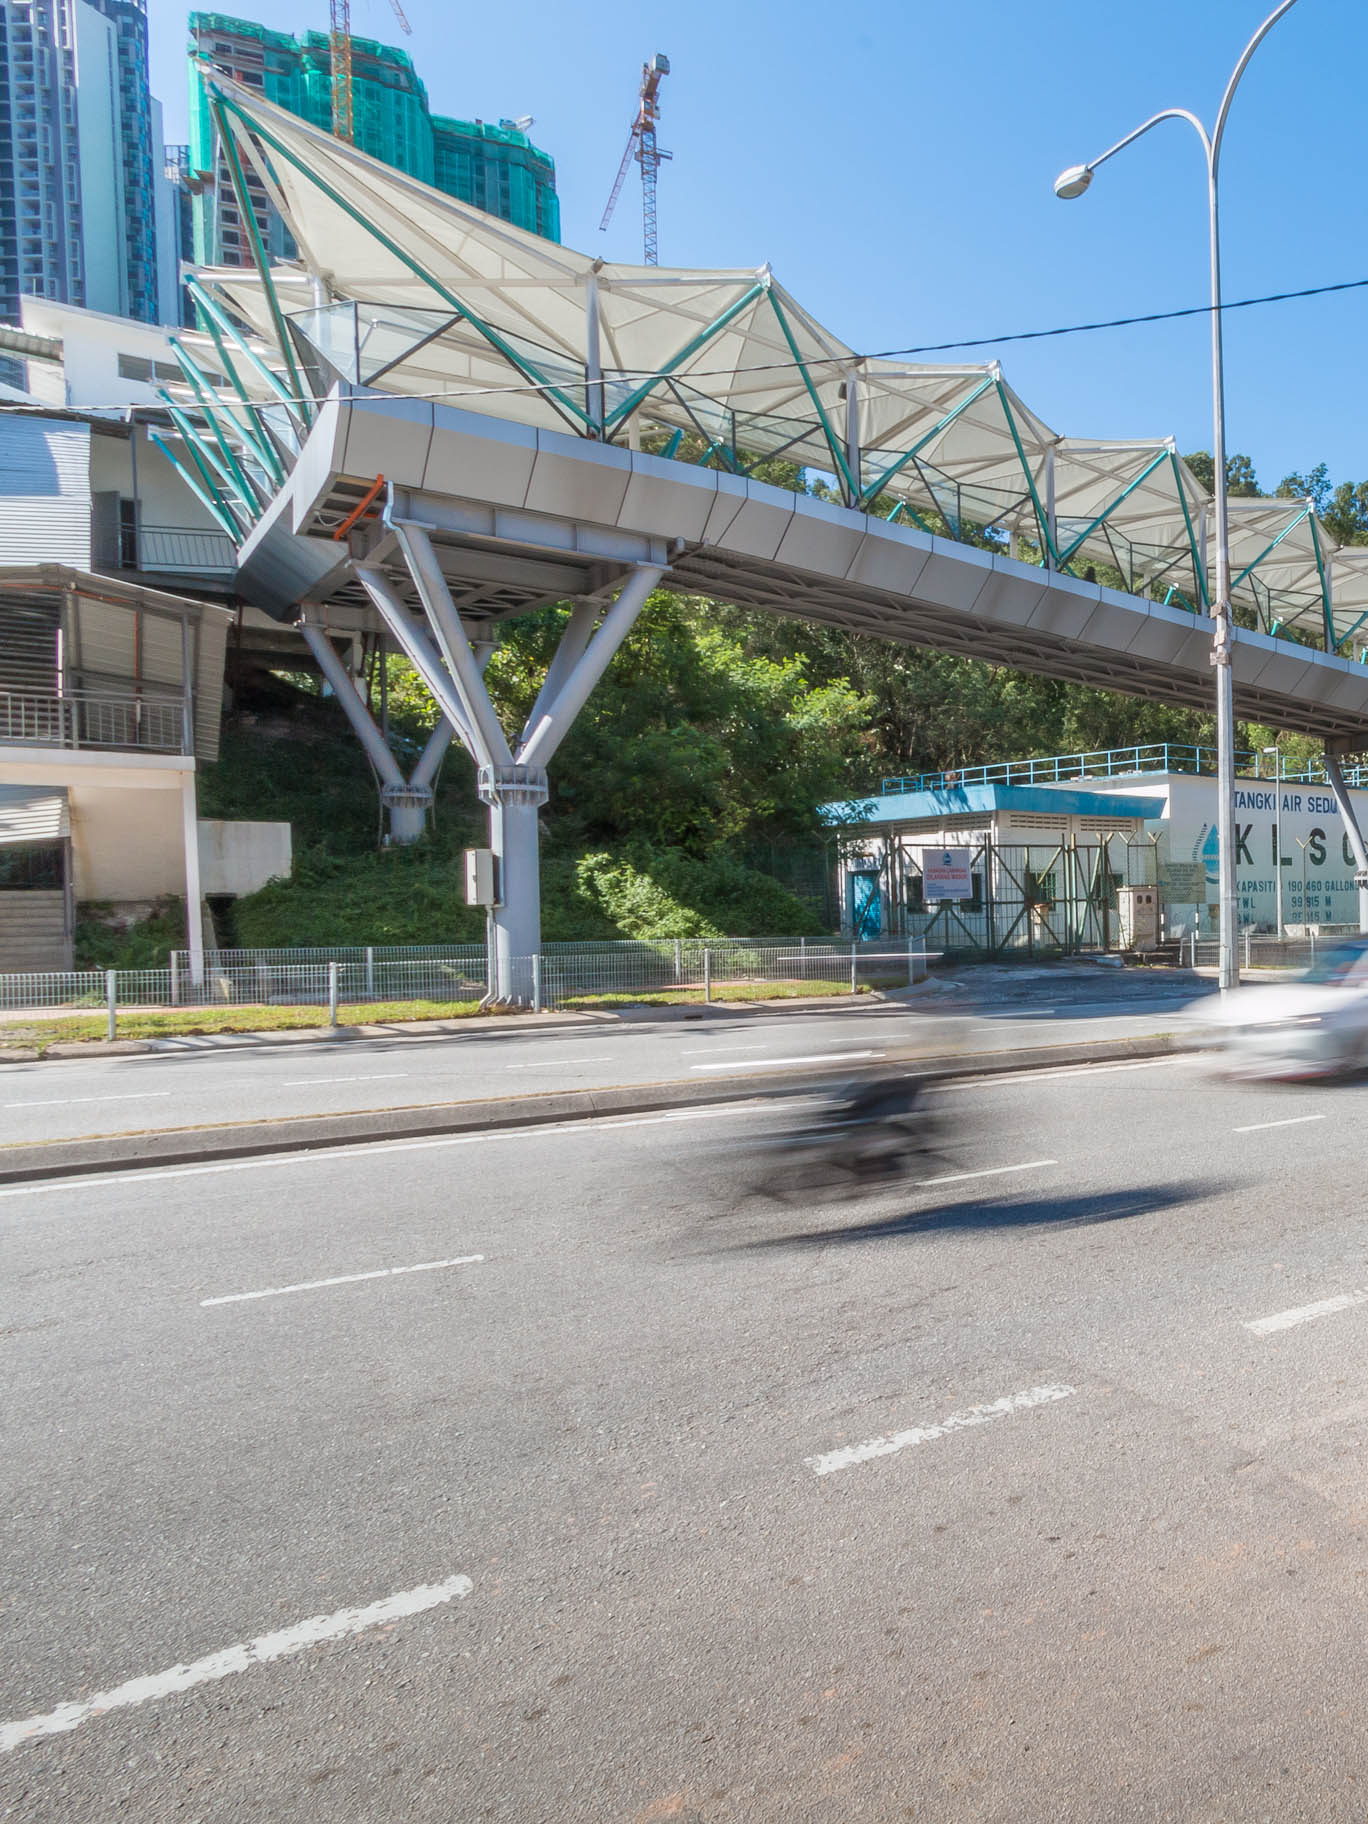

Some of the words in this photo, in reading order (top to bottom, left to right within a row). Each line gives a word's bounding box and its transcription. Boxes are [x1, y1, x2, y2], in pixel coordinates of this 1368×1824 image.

[1235, 792, 1276, 811] TANGKI
[1282, 794, 1302, 812] AIR
[1308, 796, 1337, 814] SEDU
